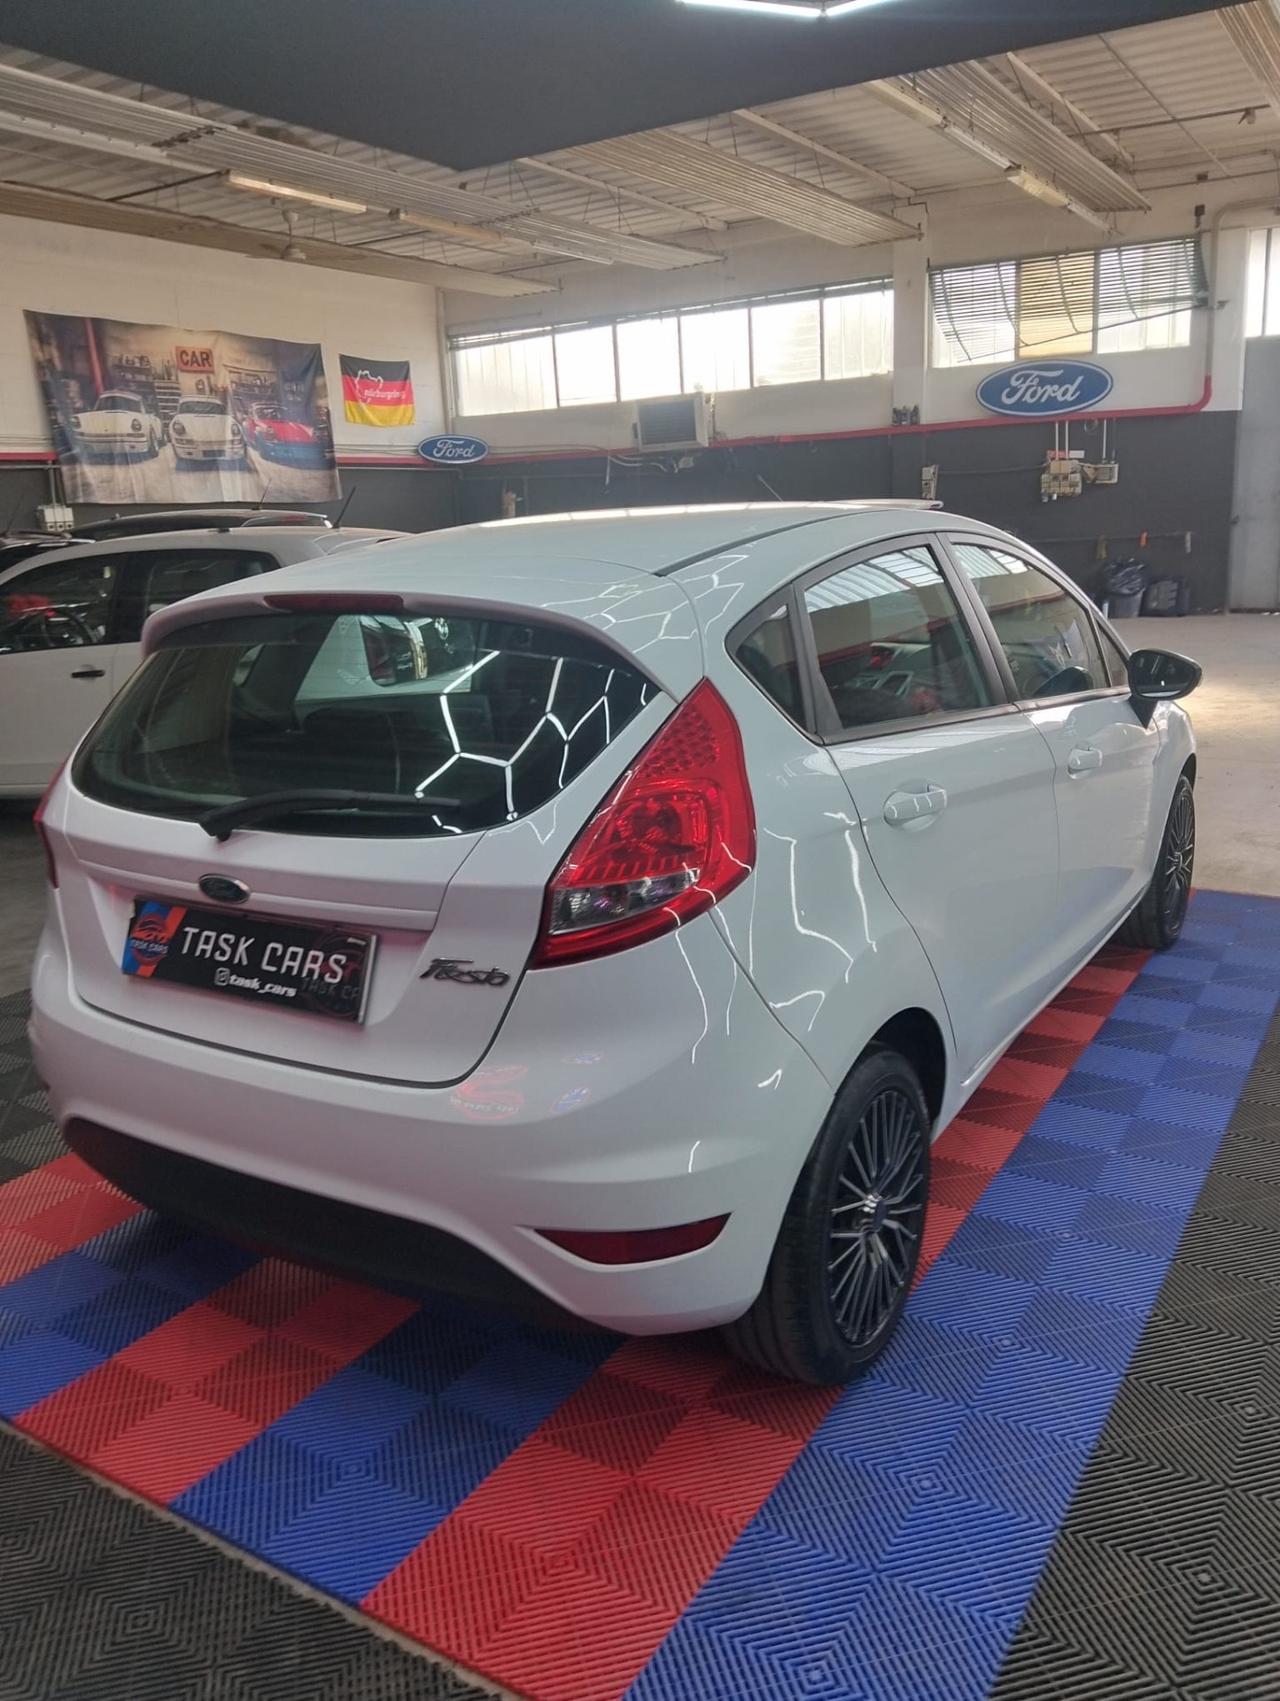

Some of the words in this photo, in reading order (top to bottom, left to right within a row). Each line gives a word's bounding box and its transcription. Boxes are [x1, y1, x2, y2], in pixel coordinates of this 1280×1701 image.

[180, 350, 212, 367] CAR
[1001, 369, 1084, 405] Ford
[433, 439, 475, 458] Ford
[181, 926, 255, 966] TASK
[260, 942, 347, 984] CARS
[229, 974, 298, 997] task_cars
